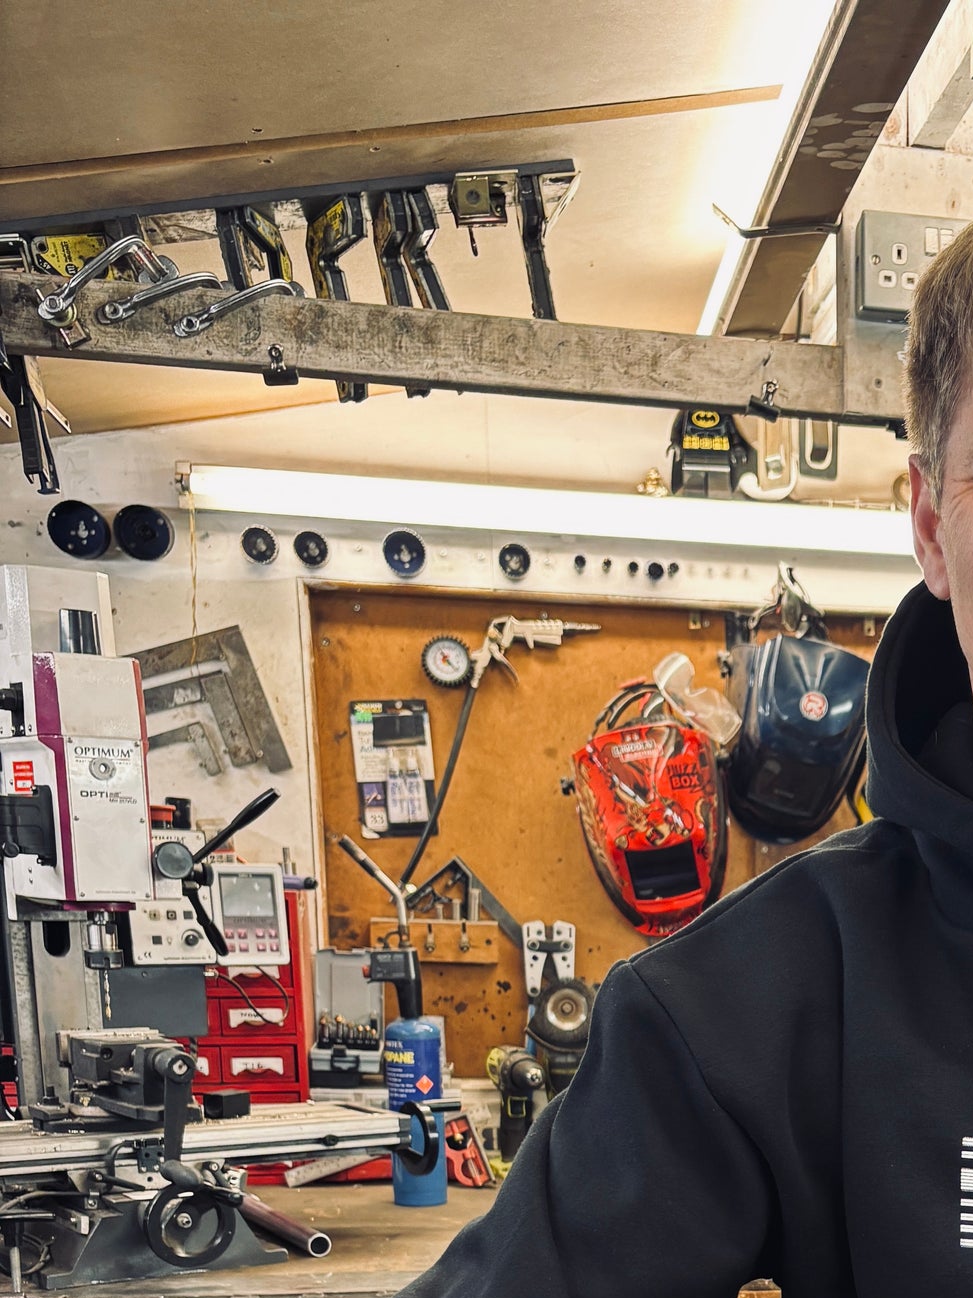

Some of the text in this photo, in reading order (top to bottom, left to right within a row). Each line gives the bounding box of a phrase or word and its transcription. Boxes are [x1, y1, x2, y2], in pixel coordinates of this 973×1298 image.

[74, 746, 131, 759] OPTIMUM
[672, 775, 700, 788] BOX
[384, 1050, 415, 1065] OPANE
